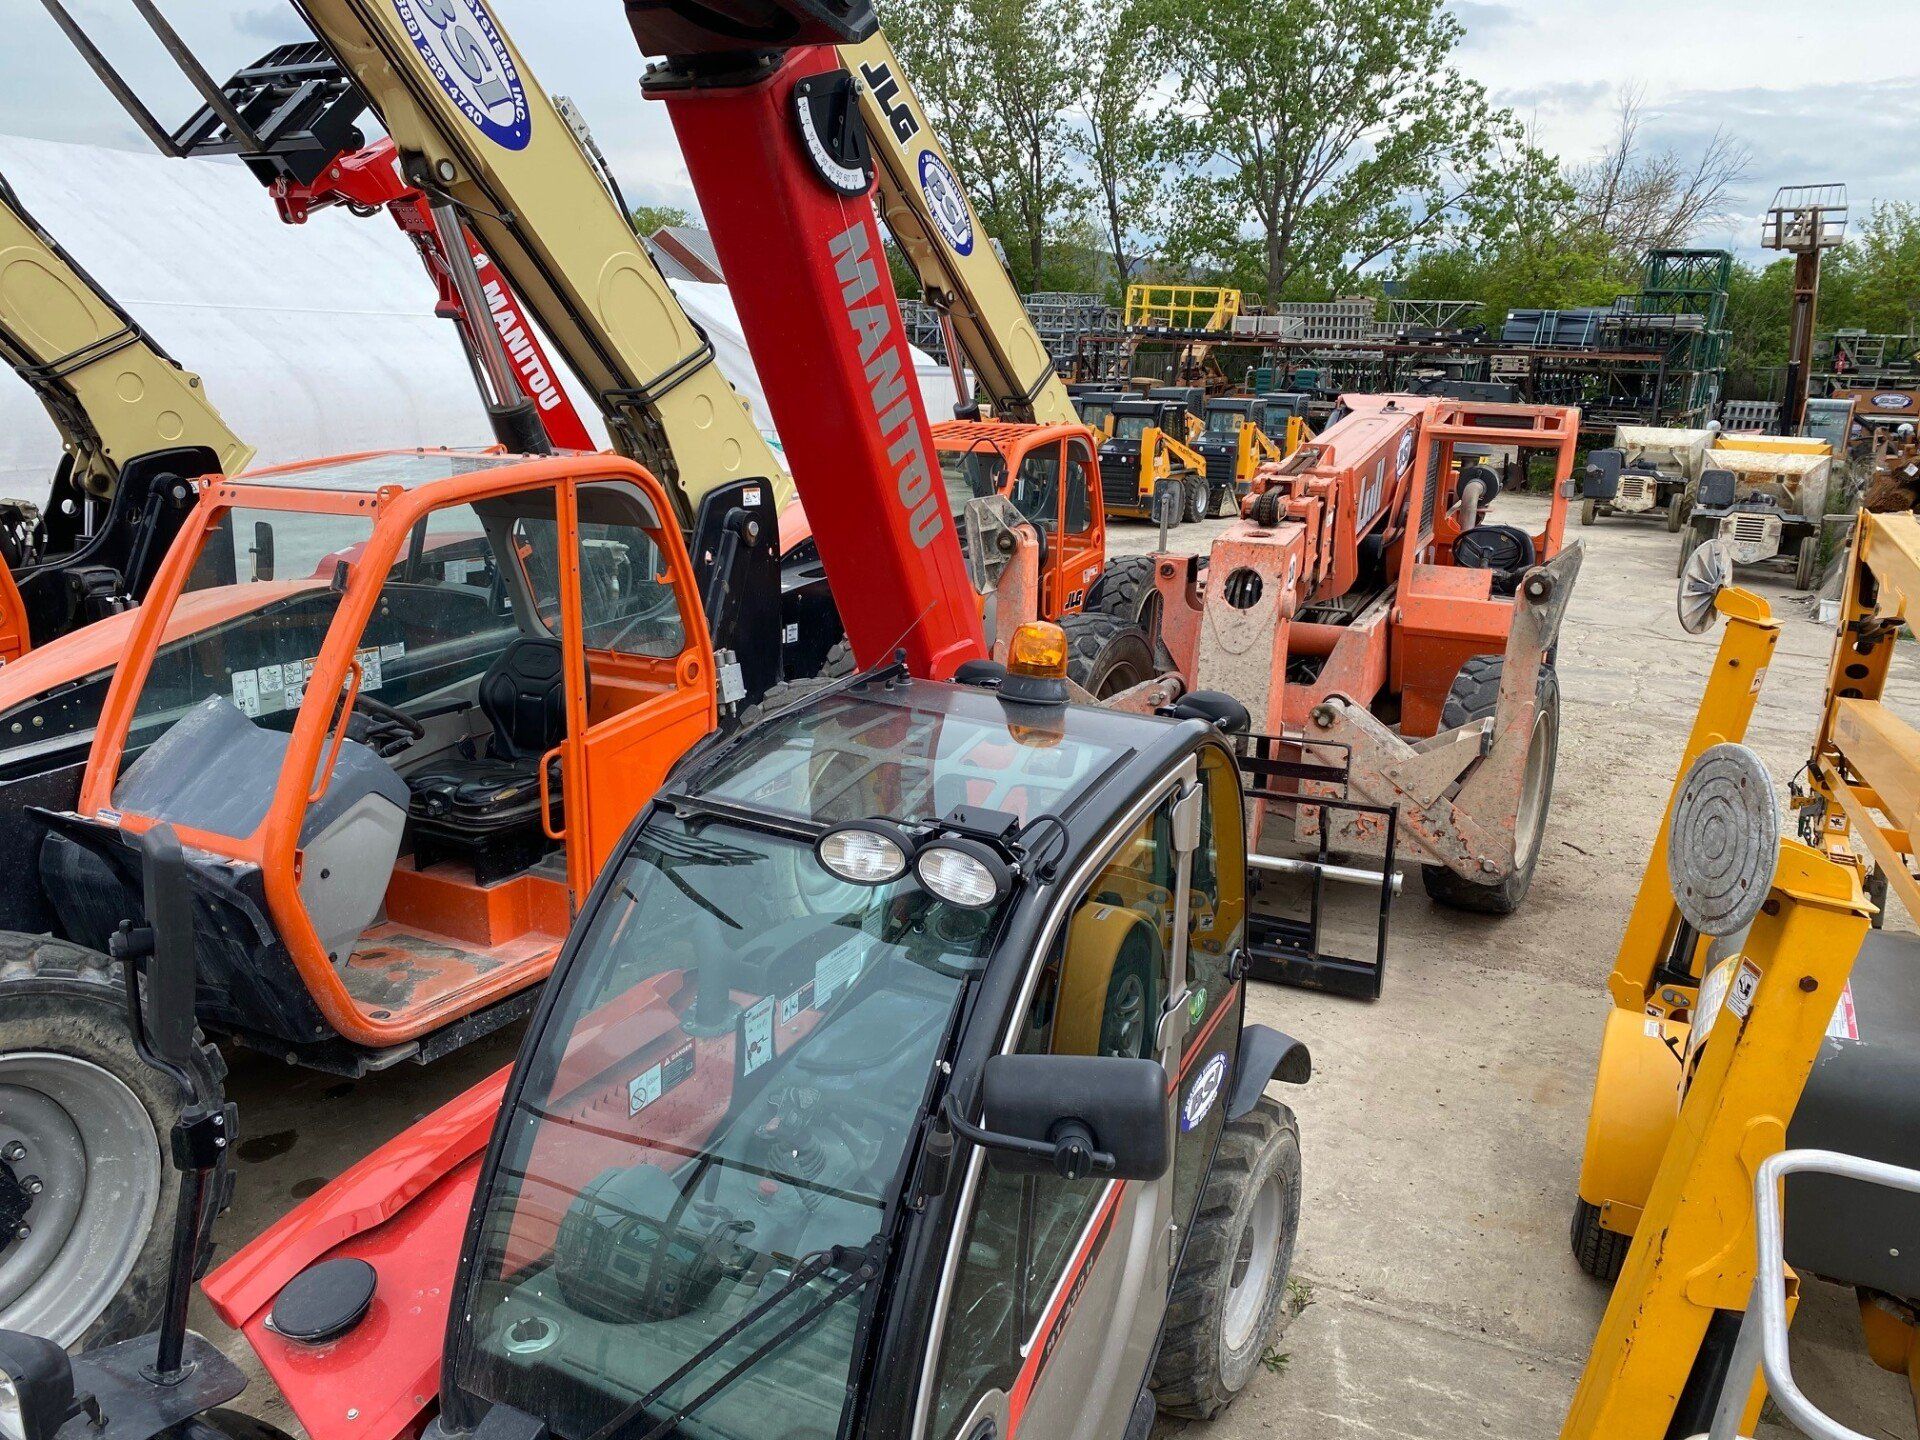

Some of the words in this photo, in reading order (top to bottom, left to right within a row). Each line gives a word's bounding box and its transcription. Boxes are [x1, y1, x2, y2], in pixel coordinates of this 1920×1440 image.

[420, 47, 483, 126] 259-4740
[511, 86, 527, 124] INC.
[858, 60, 921, 147] JLG
[926, 167, 968, 238] BSI
[483, 280, 562, 411] MANITOU
[828, 220, 944, 549] MANITOU
[1064, 589, 1084, 610] JLG
